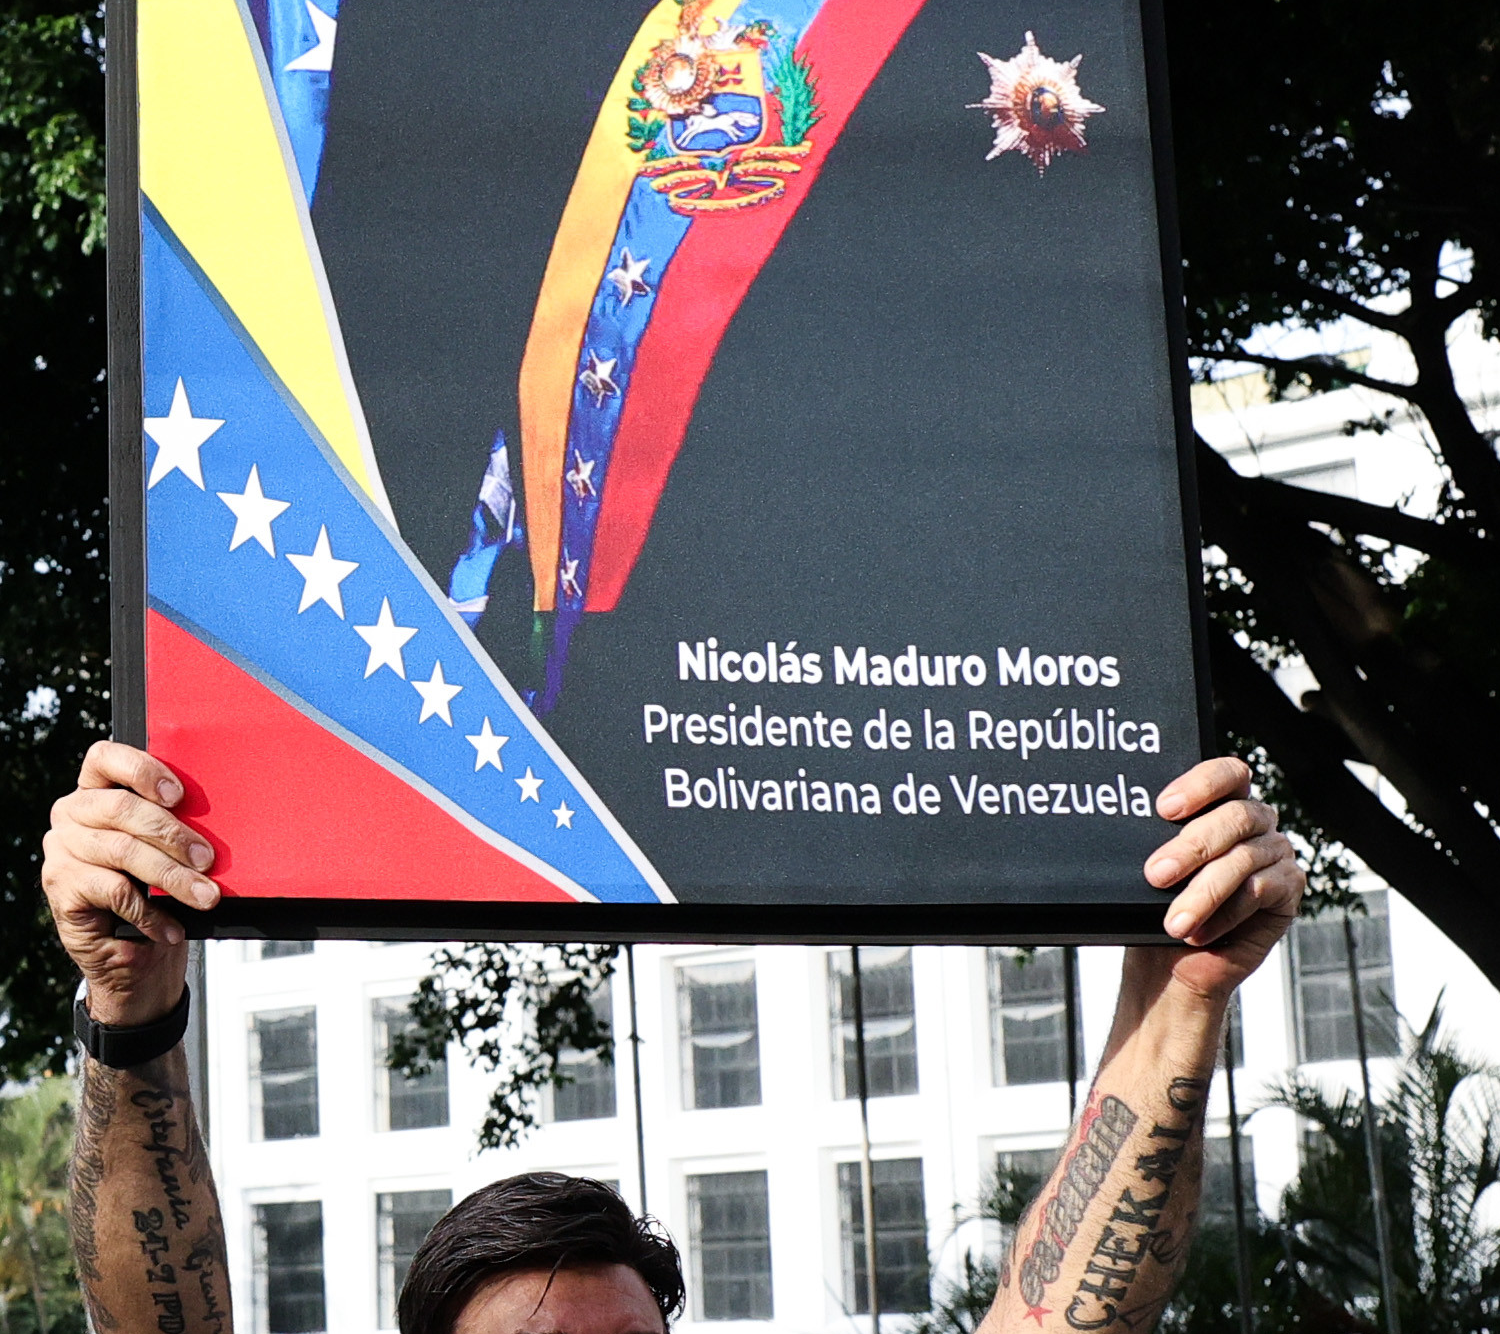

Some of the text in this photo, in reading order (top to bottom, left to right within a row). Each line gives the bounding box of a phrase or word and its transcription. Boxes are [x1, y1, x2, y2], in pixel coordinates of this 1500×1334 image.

[678, 637, 1121, 688] Nicolás Maduro Moros
[642, 702, 1160, 760] Presidente de la República
[664, 766, 1152, 817] Bolivariana de Venezuela
